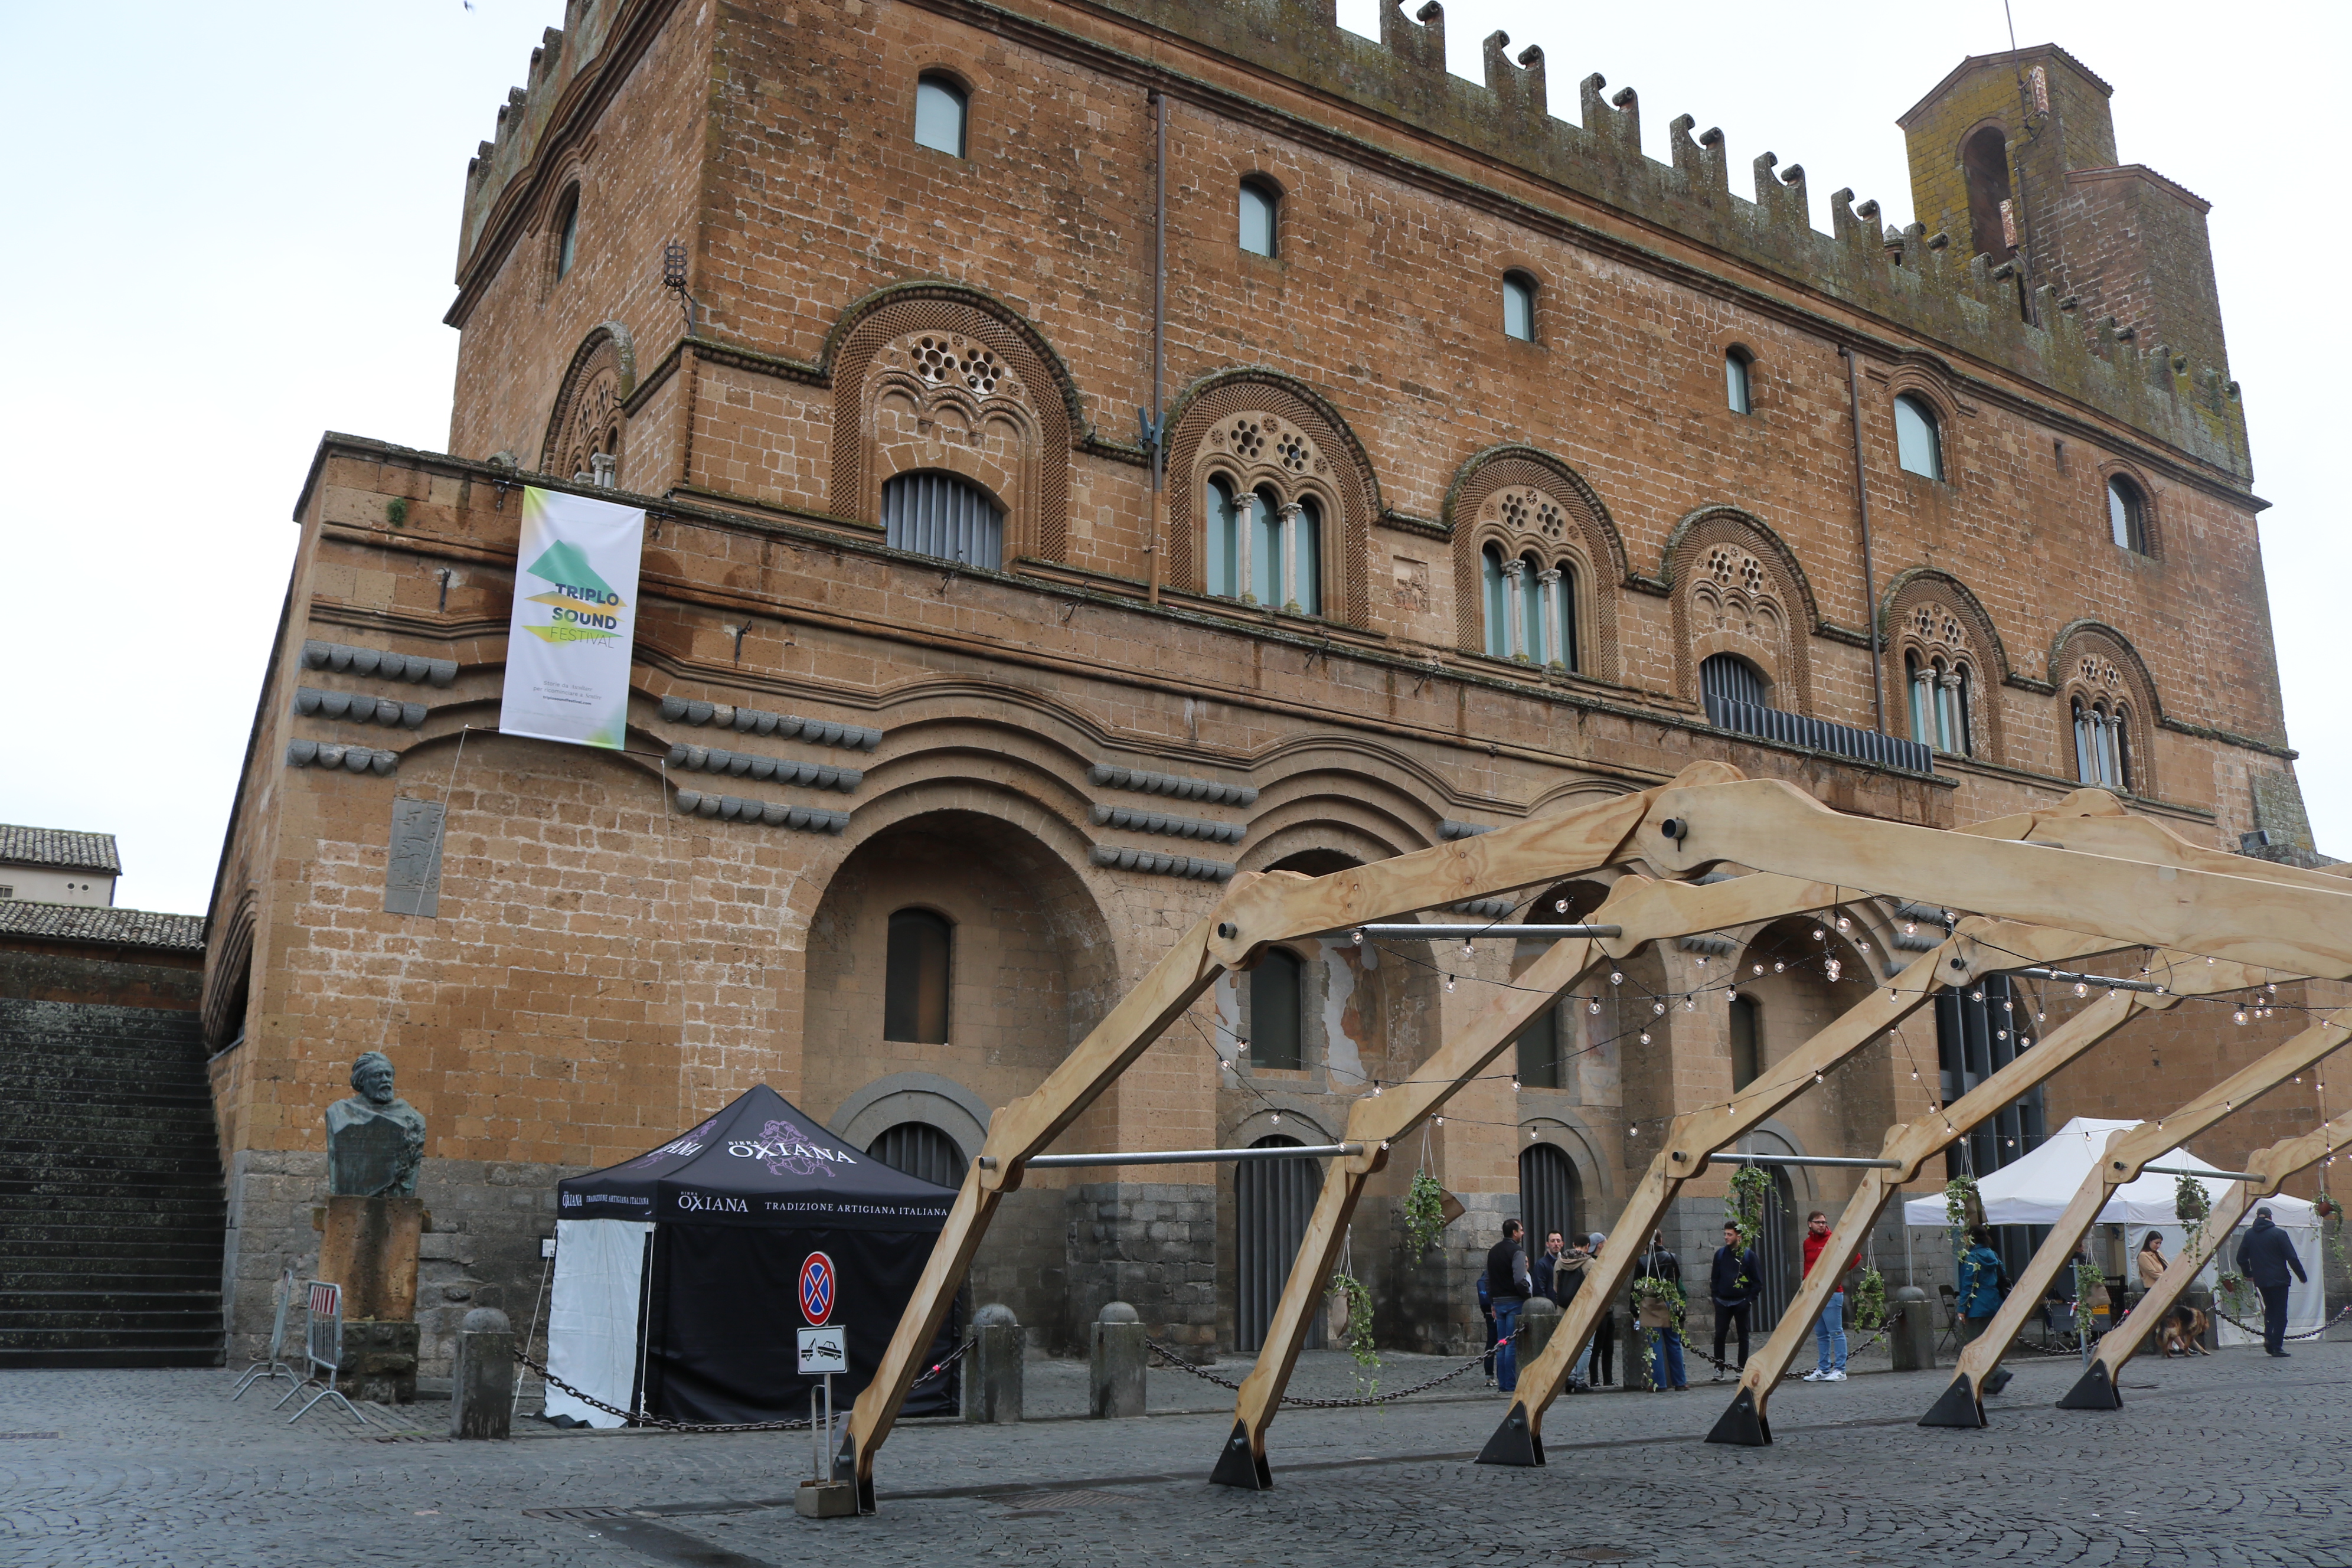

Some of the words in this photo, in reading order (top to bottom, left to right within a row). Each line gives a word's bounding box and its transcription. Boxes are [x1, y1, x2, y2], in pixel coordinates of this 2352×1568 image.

[556, 583, 619, 606] TRIPLO
[552, 606, 617, 629] SOUND
[550, 626, 614, 649] FESTIVAL
[543, 695, 592, 705] triplosoundfestival.com
[544, 688, 578, 697] ricominciare
[727, 1139, 857, 1164] OXIANA
[562, 1194, 582, 1208] OXIANA
[586, 1194, 608, 1203] TRADIZIONE
[608, 1195, 629, 1204] ARTIGIANA
[629, 1197, 649, 1205] ITALIANA
[678, 1193, 749, 1212] OXIANA
[765, 1201, 834, 1211] TRADIZIONE
[837, 1204, 896, 1214] ARTIGIANA
[899, 1207, 948, 1216] ITALIANA
